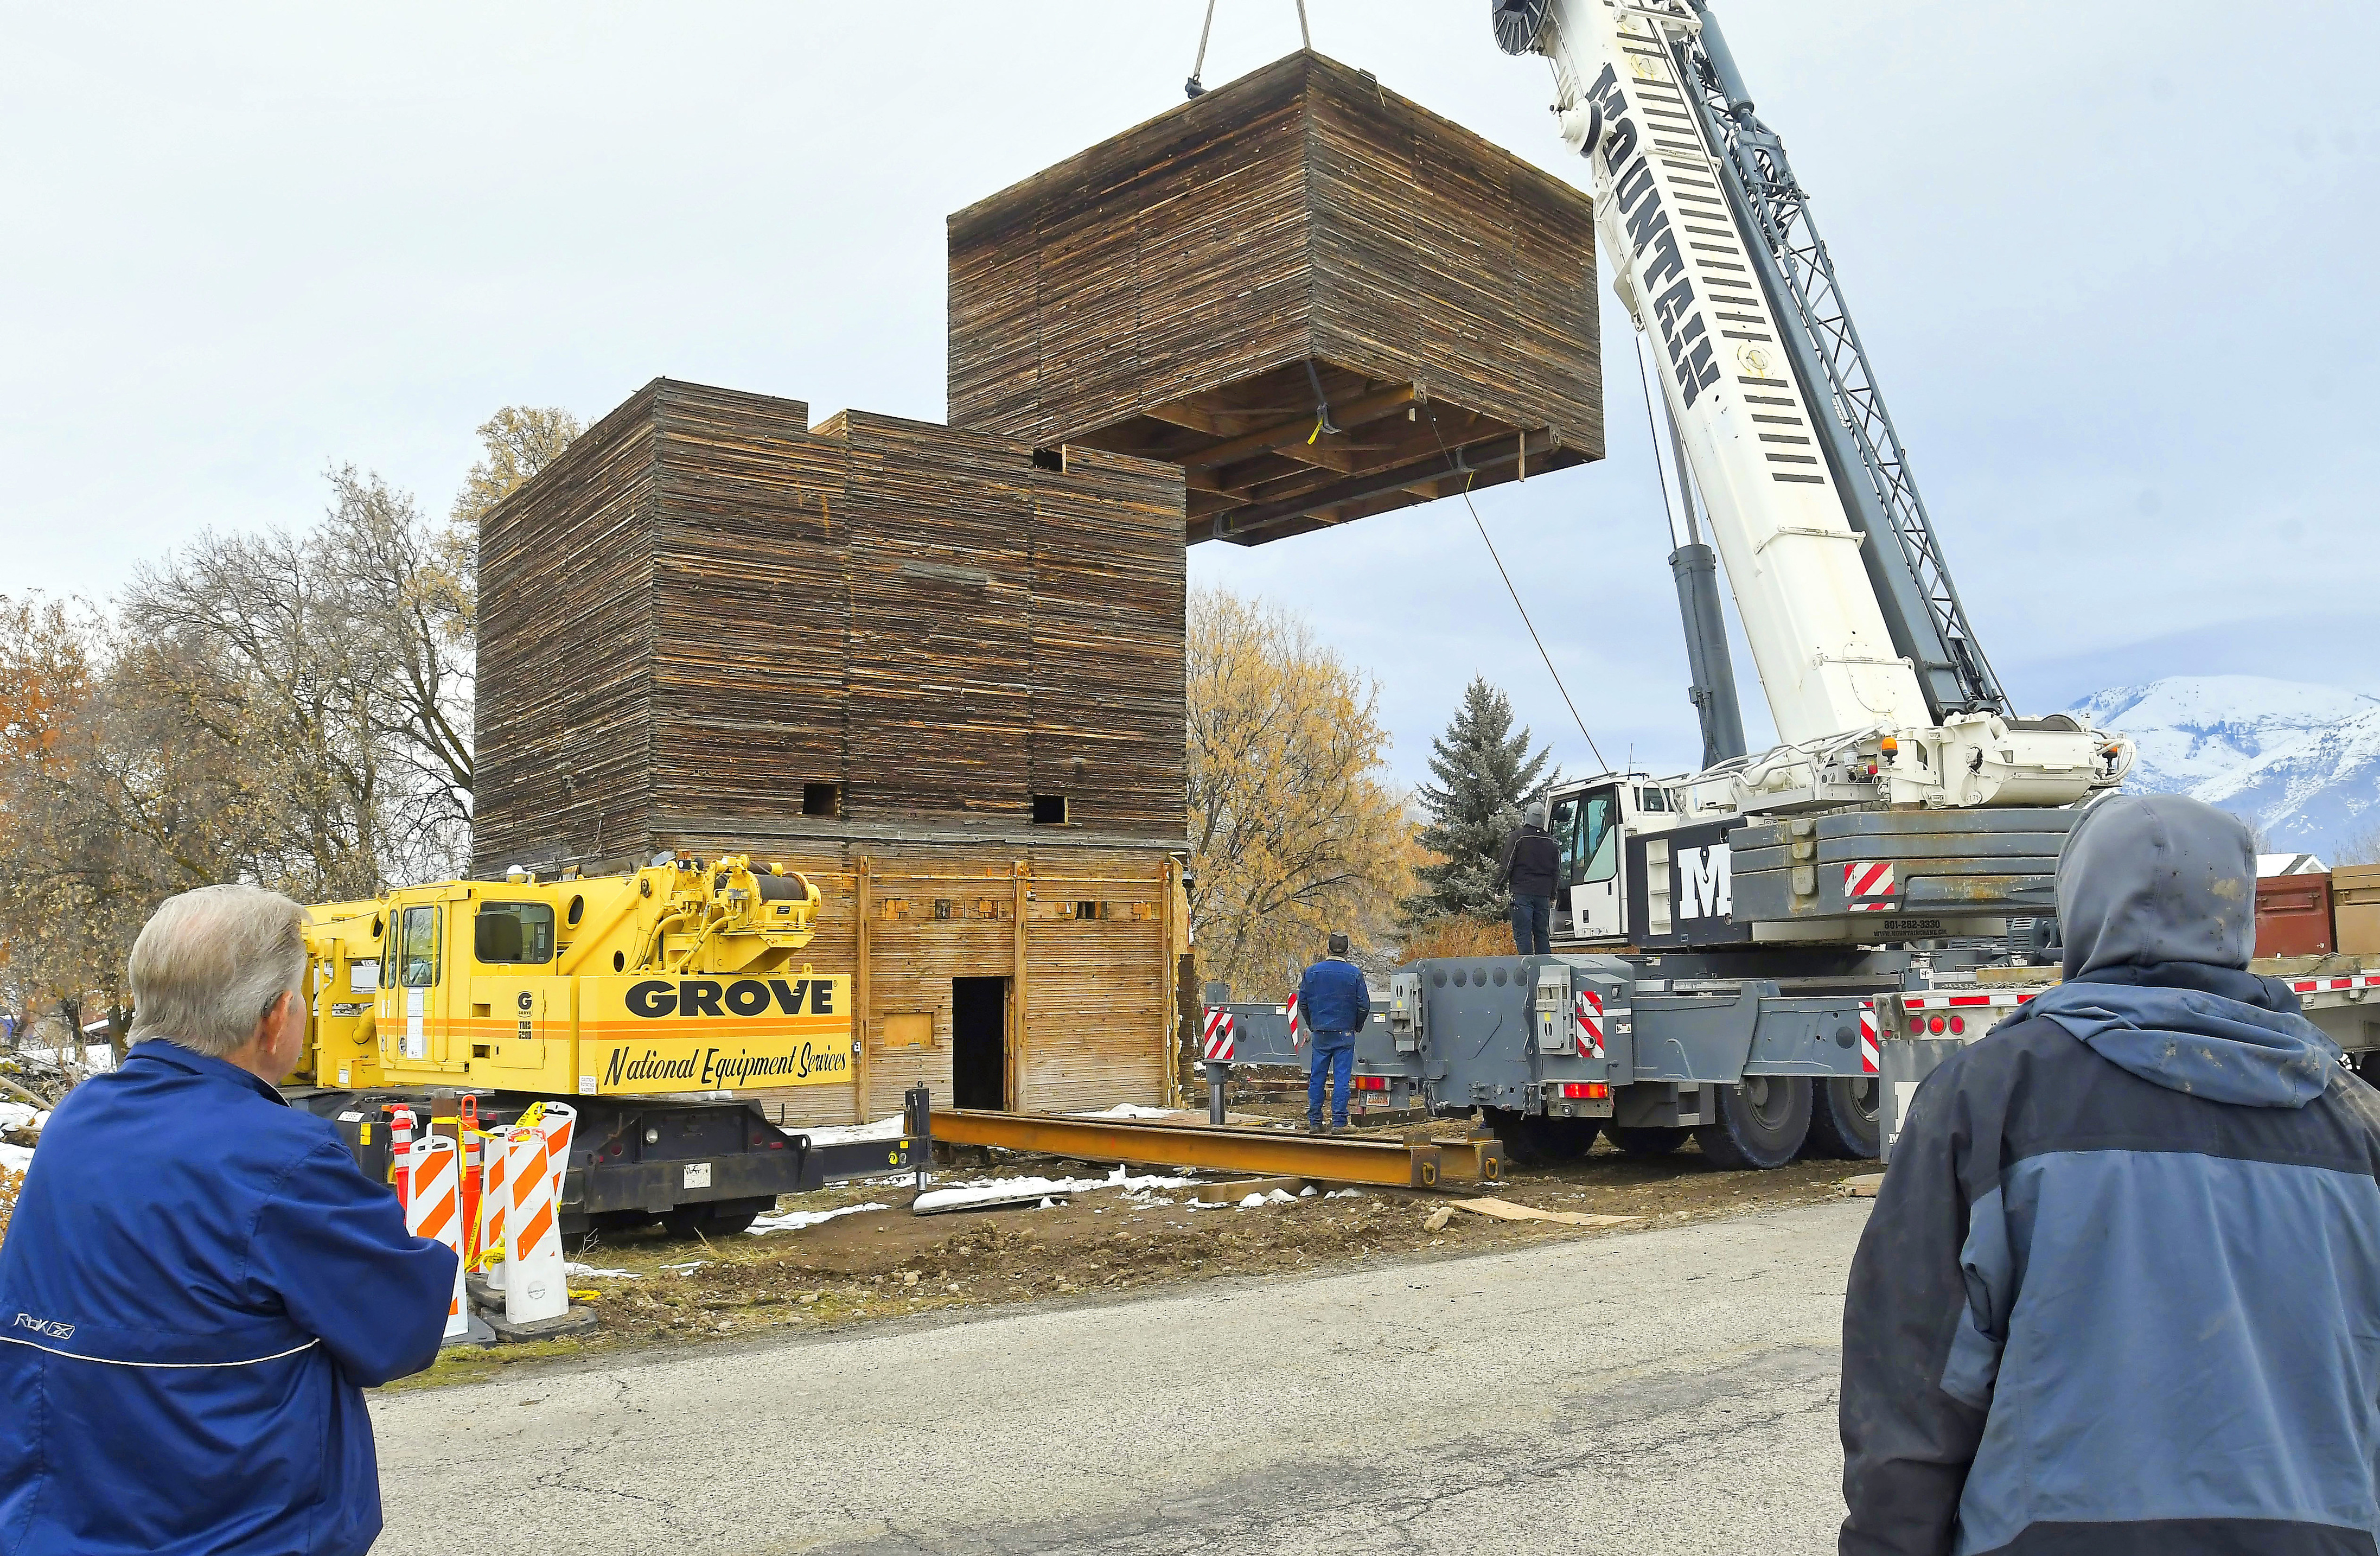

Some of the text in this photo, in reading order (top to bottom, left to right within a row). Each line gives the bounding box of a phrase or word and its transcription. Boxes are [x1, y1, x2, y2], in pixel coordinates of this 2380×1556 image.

[1585, 62, 1721, 411] MOUNTAIN
[1677, 843, 1733, 920] M
[1884, 920, 1941, 929] 801-282-3330
[626, 979, 833, 1018] GROVE
[603, 1041, 846, 1089] National Equipment Services
